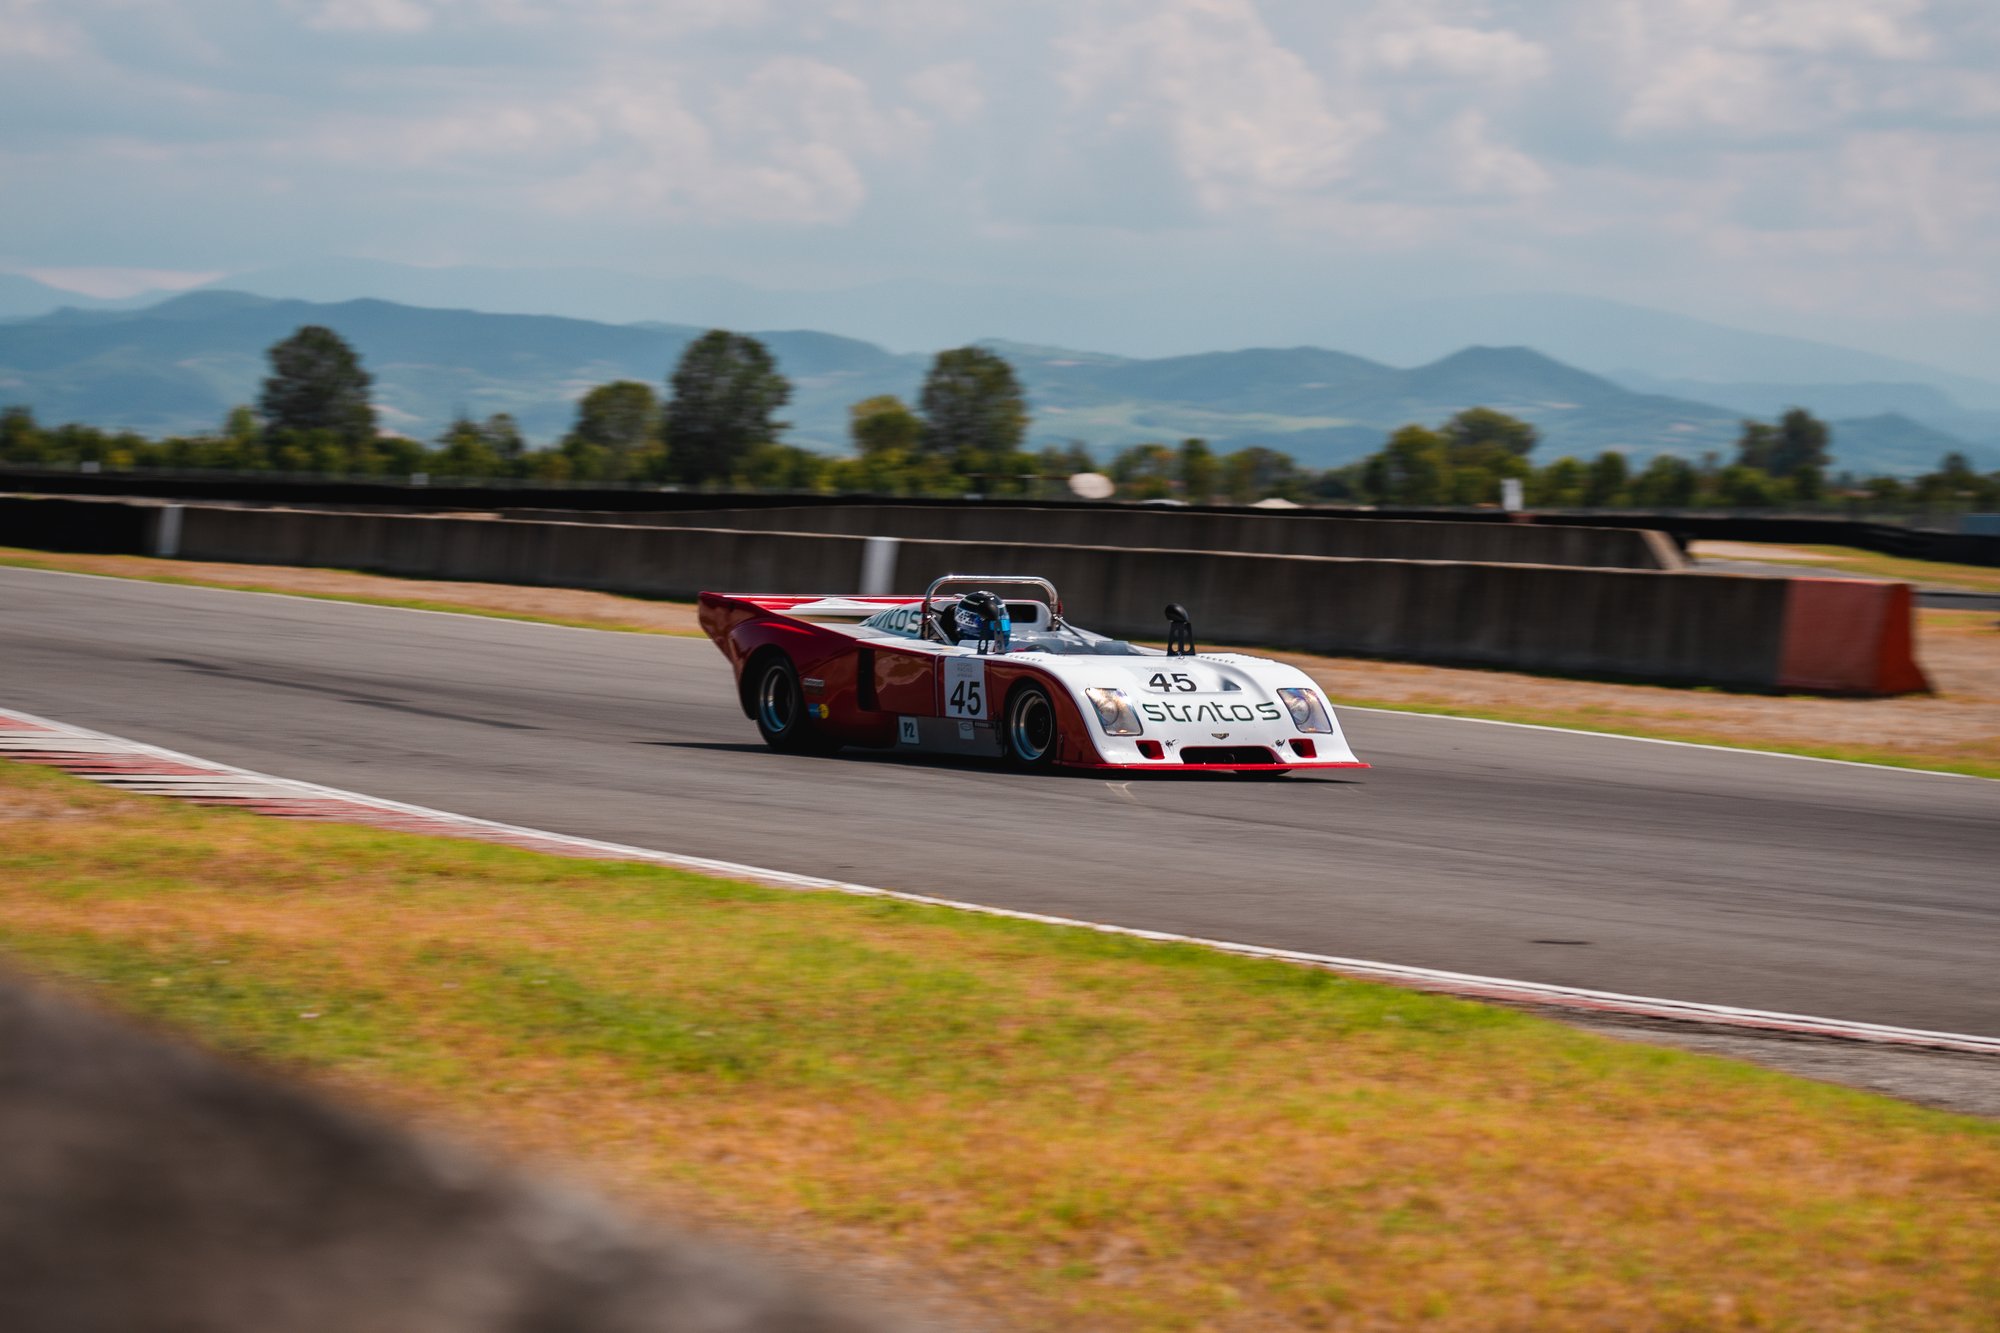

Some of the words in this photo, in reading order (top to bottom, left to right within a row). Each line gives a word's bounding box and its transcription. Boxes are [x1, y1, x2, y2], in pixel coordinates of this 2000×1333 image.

[1149, 673, 1197, 693] 45
[950, 680, 981, 716] 45
[1142, 701, 1281, 722] stratos
